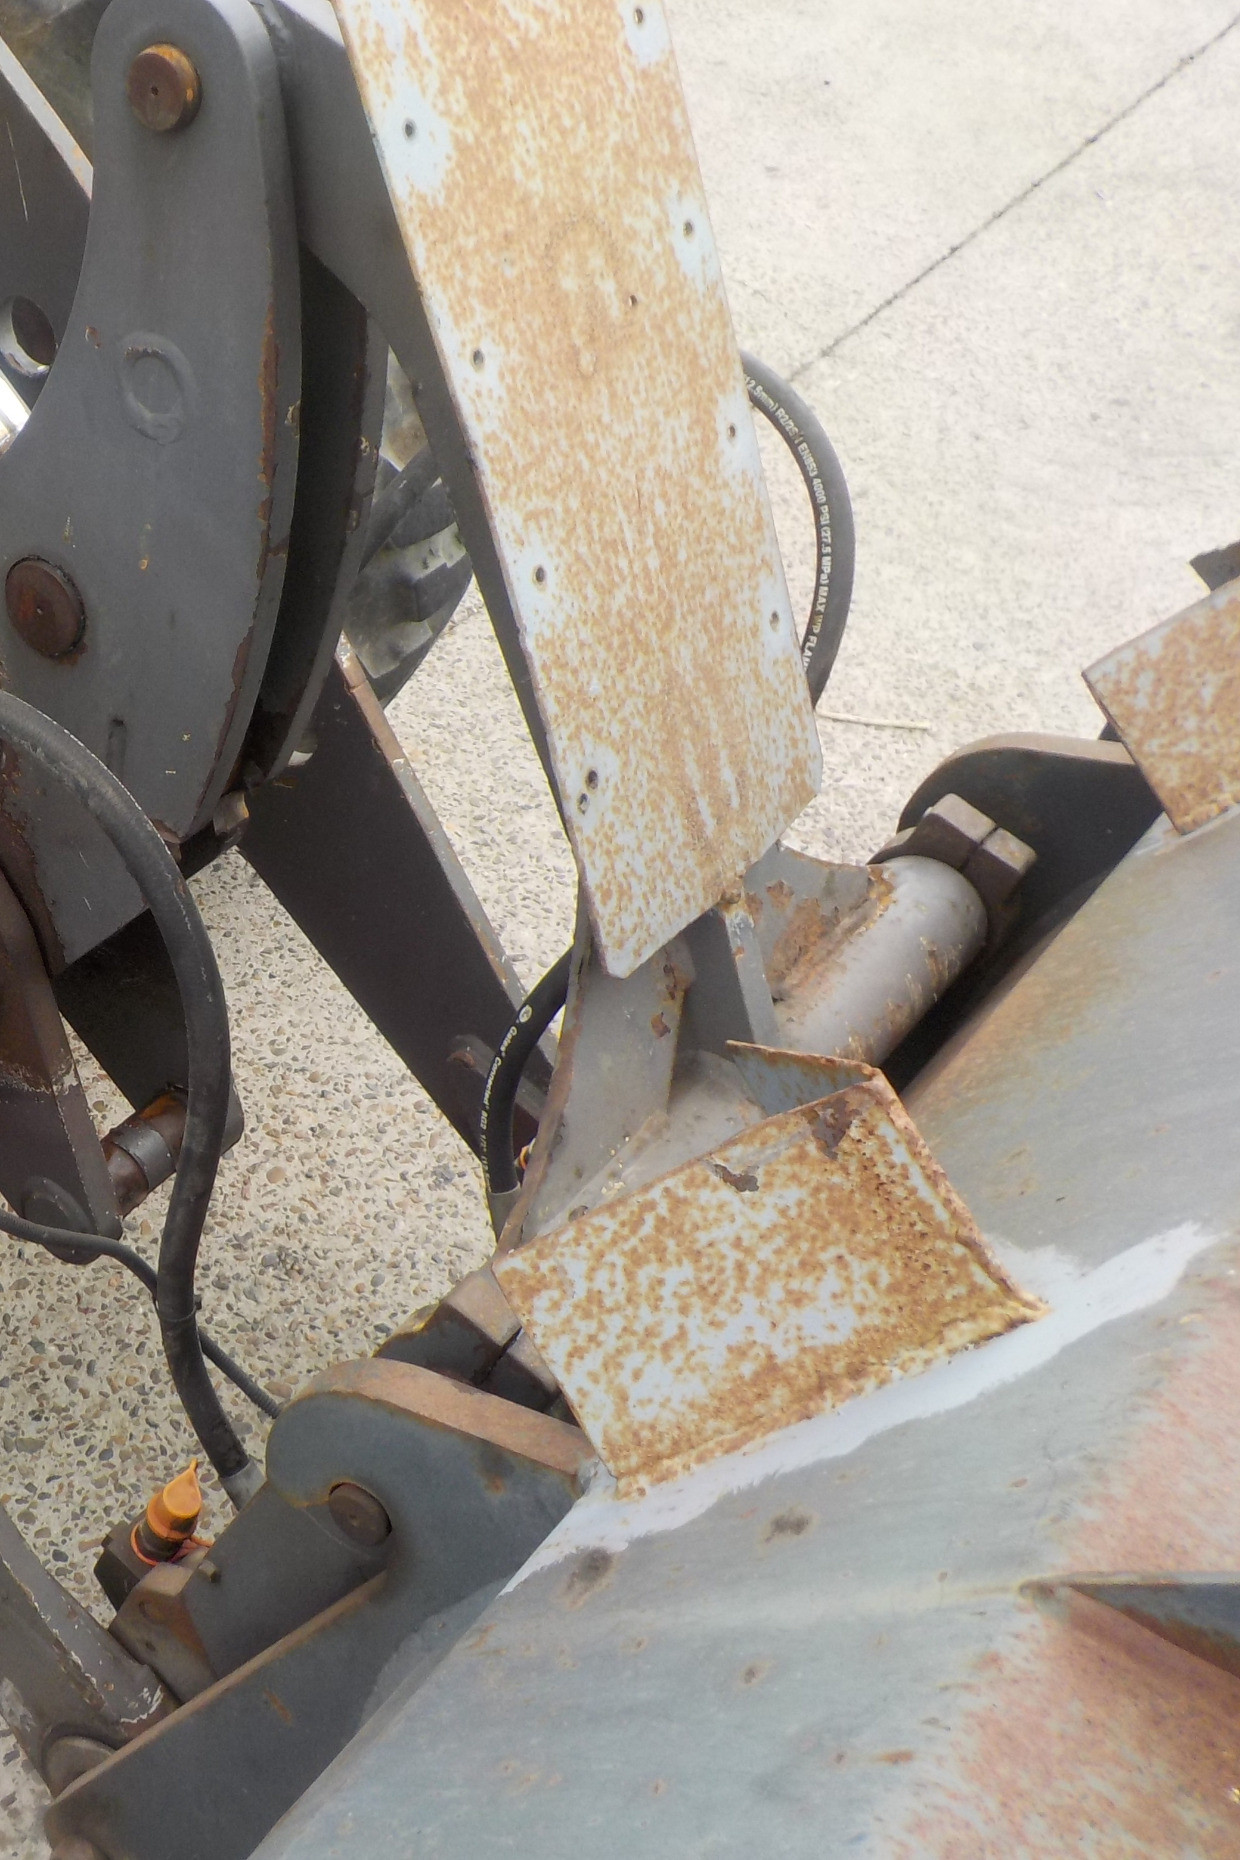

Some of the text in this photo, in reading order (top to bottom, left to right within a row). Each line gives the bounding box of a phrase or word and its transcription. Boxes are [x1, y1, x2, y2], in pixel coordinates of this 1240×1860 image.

[743, 374, 779, 412] 12.5mm)
[813, 478, 828, 504] 4000
[820, 505, 831, 525] PSI
[821, 526, 832, 554] (27.5
[820, 555, 832, 584] MPa)
[816, 586, 829, 613] MAX
[802, 635, 818, 671] FLAM
